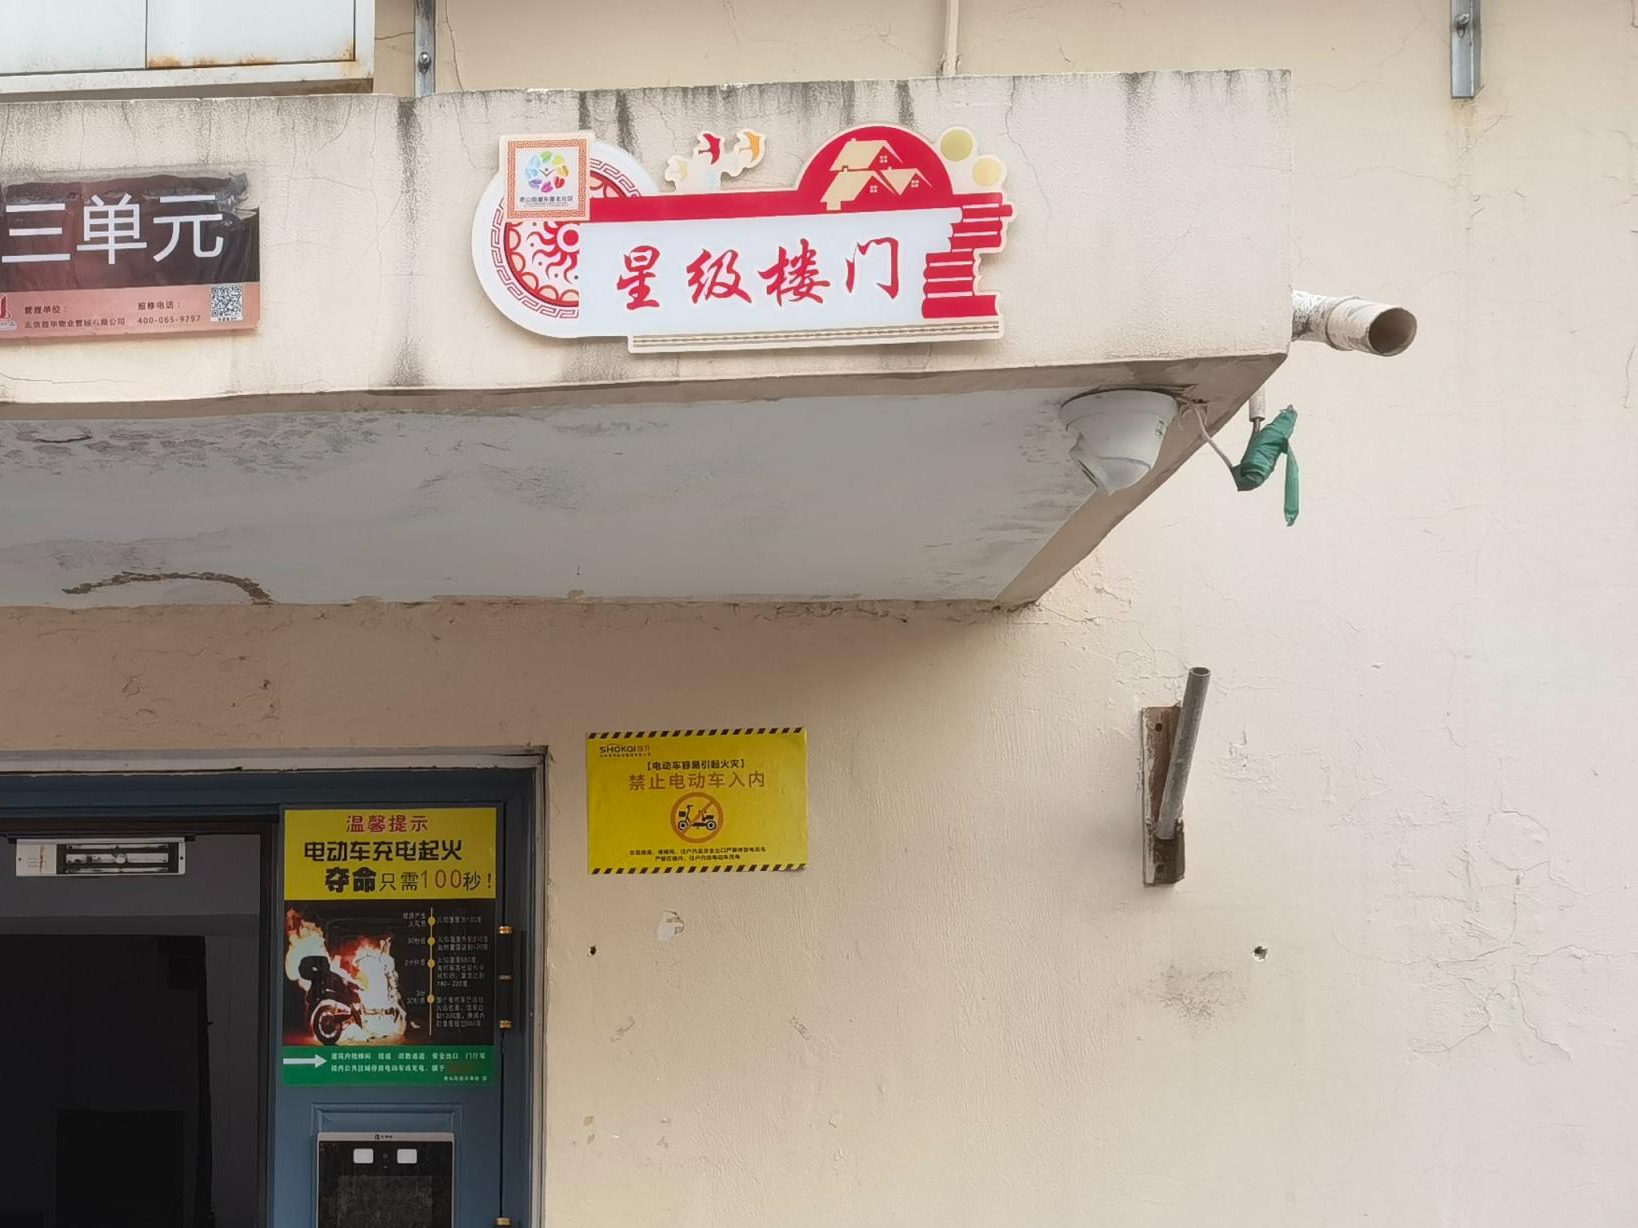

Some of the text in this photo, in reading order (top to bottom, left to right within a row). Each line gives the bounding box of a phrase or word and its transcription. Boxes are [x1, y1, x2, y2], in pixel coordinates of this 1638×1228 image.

[1, 192, 224, 265] 三单元
[616, 236, 901, 311] 星级楼门
[628, 770, 766, 792] 禁止电动车入内
[346, 814, 429, 833] 温馨提示
[304, 839, 463, 862] 电动车充电起火
